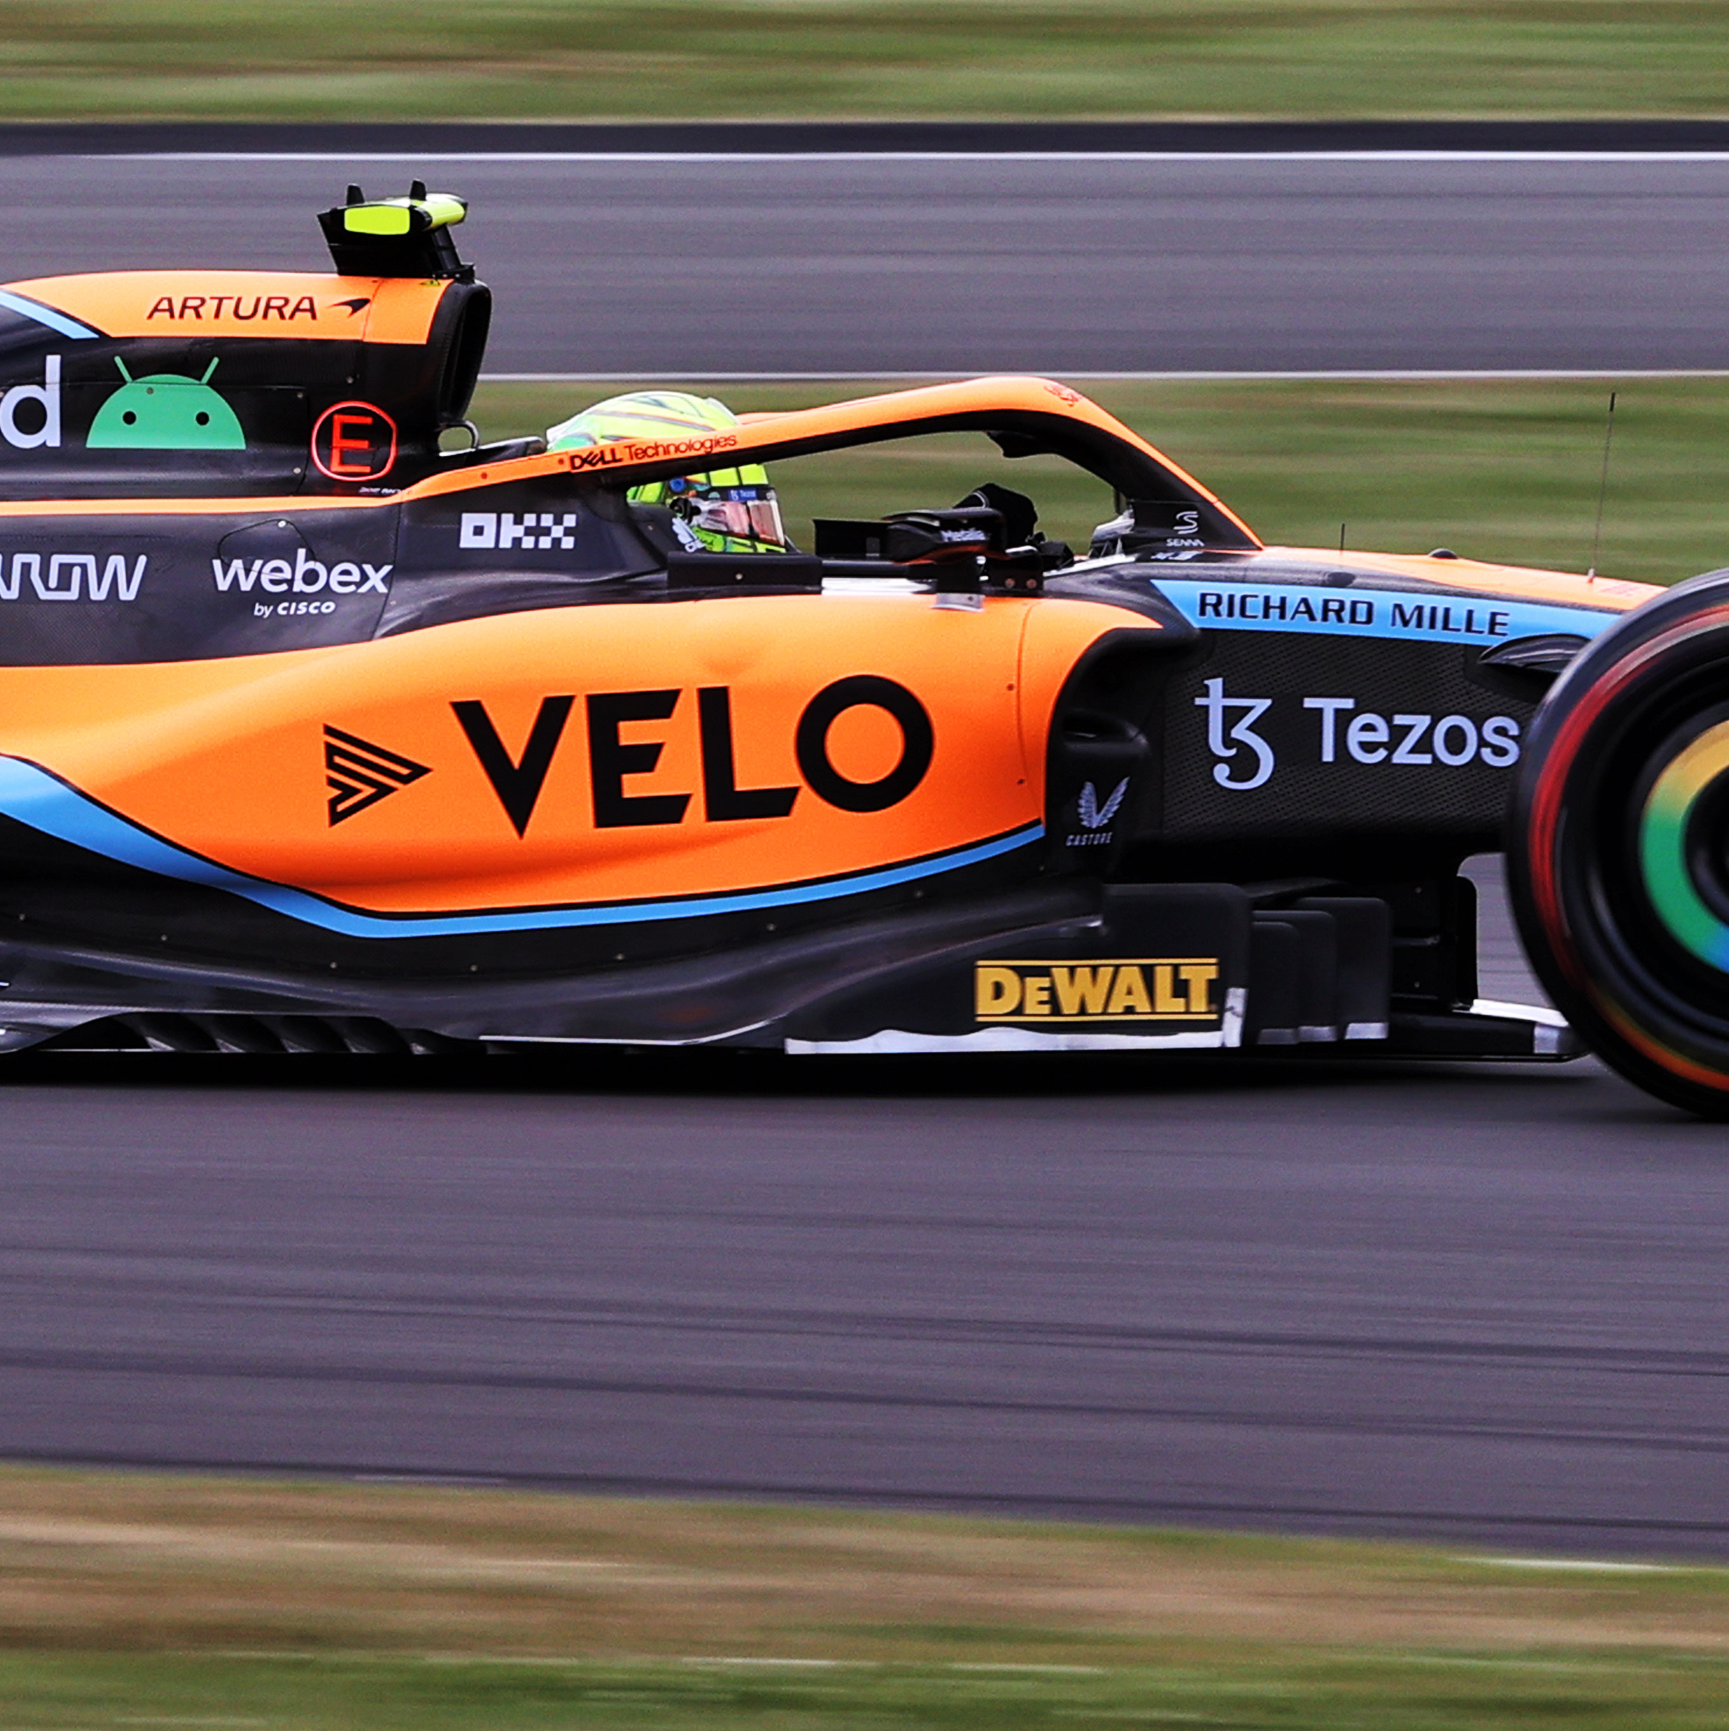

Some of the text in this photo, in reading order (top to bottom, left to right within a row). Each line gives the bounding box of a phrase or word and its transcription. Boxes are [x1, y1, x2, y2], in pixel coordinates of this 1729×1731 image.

[147, 296, 318, 321] ARTURA
[569, 434, 738, 470] DELL Technologies
[459, 513, 576, 549] OKX
[211, 547, 394, 594] webex
[253, 601, 336, 618] by CISCO
[1198, 592, 1510, 637] RICHARD MILLE
[1303, 698, 1521, 768] Tezos
[449, 673, 935, 841] VELO
[1065, 832, 1113, 847] CASTORE
